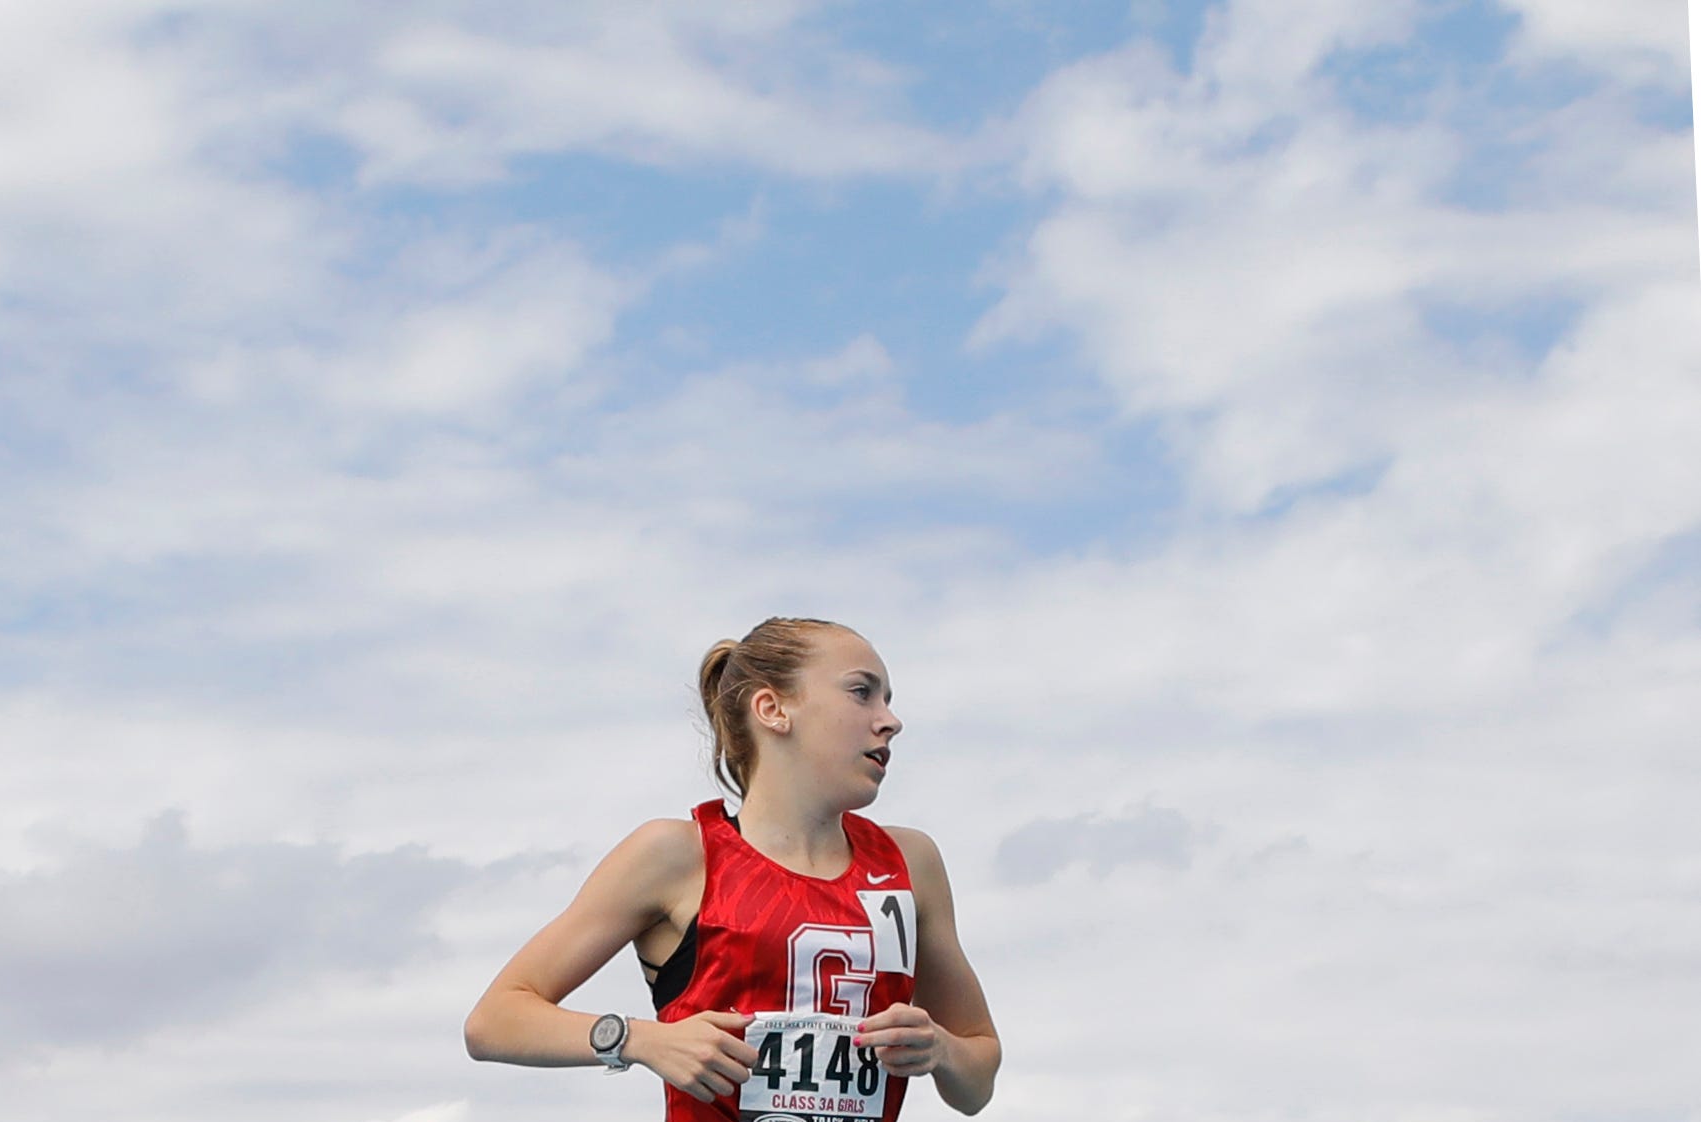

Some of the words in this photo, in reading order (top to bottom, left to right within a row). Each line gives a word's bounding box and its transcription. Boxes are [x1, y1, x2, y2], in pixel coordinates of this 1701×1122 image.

[881, 896, 908, 970] 1
[786, 922, 876, 1016] G
[751, 1031, 879, 1097] 4148
[772, 1094, 815, 1110] CLASS
[819, 1097, 834, 1112] 3A
[837, 1098, 865, 1114] GIRLS
